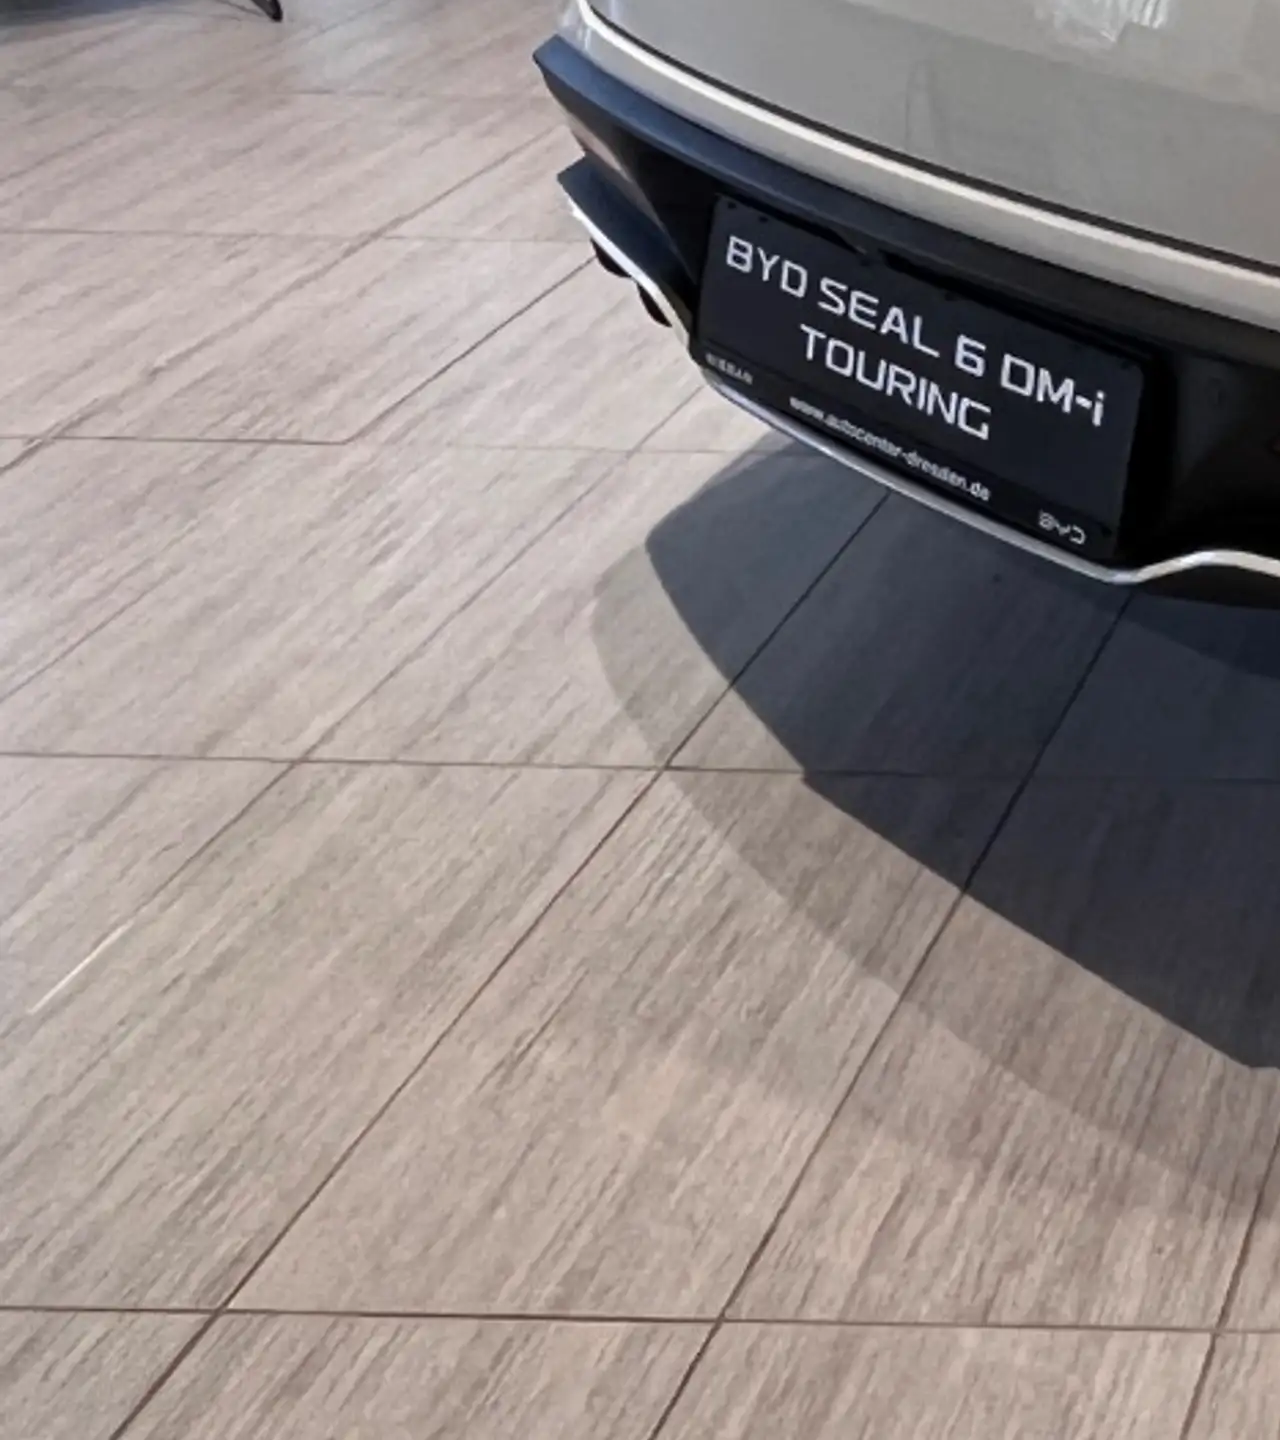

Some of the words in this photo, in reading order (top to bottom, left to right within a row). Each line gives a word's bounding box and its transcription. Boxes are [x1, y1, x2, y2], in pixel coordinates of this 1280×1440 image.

[726, 235, 808, 298] BYD
[818, 276, 940, 357] SEAL
[955, 334, 987, 377] 6
[1000, 353, 1104, 427] DM-i
[800, 323, 992, 440] TOURING
[1038, 509, 1086, 545] BYD
